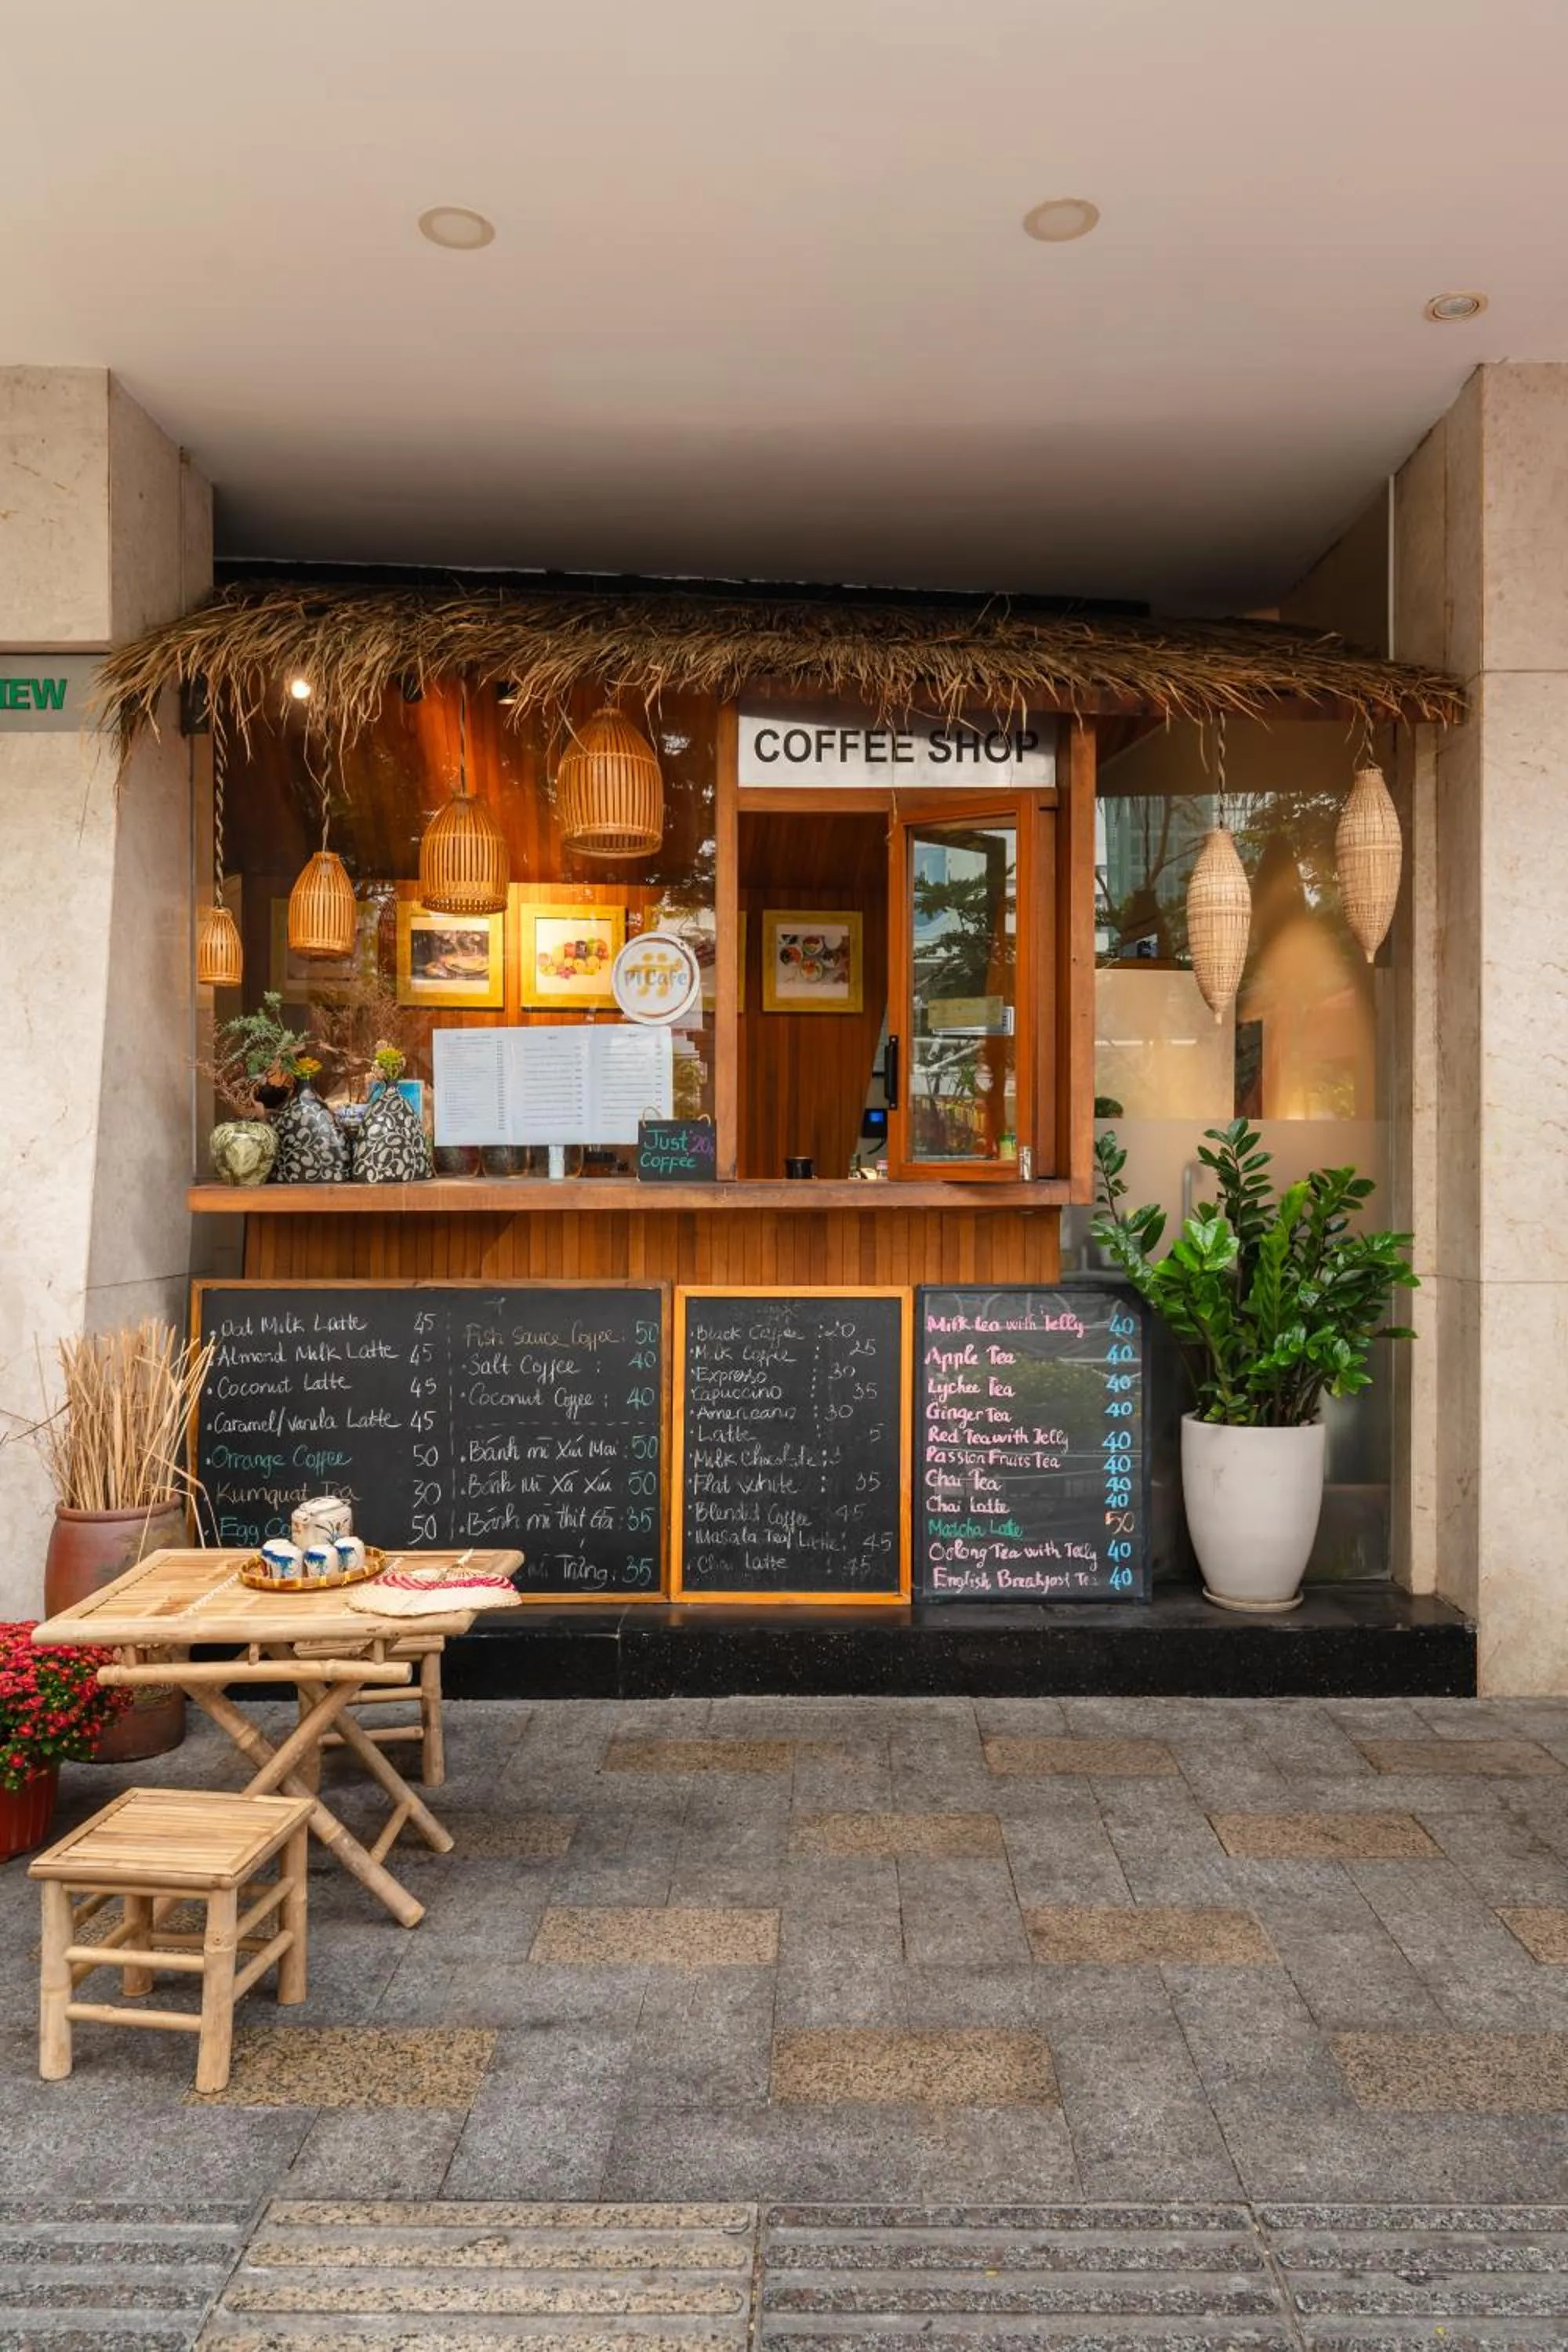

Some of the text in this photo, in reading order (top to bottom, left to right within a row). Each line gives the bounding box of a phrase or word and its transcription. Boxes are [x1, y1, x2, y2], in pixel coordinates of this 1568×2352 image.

[754, 728, 1039, 763] COFFEE SHOP
[644, 1129, 688, 1152] Just
[640, 1152, 696, 1174] Coffee
[220, 1311, 437, 1337] Oat Milk Latte 45
[465, 1322, 504, 1348] Fish
[635, 1320, 659, 1345] 50
[927, 1315, 971, 1334] Milk
[1006, 1313, 1037, 1330] with
[1109, 1314, 1134, 1337] 40
[217, 1339, 434, 1367] Almond Milk Latte 45
[849, 1338, 877, 1356] 25
[924, 1343, 1133, 1373] Apple Tea 40
[469, 1351, 656, 1385] Salt Coffee 40
[827, 1363, 856, 1380] 30
[217, 1371, 437, 1399] Coconut Latte 45
[469, 1381, 543, 1406] Coconut
[626, 1386, 655, 1410] 40
[852, 1382, 877, 1399] 35
[927, 1374, 1132, 1403] Lychee Tea 40
[347, 1407, 401, 1428] Latte
[410, 1410, 436, 1432] 45
[824, 1404, 854, 1421] 30
[925, 1401, 1133, 1429] Ginger Tea 40
[470, 1434, 520, 1461] Bánh
[631, 1433, 658, 1459] 50
[698, 1424, 757, 1443] Latte
[927, 1425, 960, 1443] Red
[1033, 1427, 1069, 1456] Jelly
[1102, 1431, 1131, 1454] 40
[292, 1444, 353, 1476] Coffee
[412, 1443, 438, 1466] 50
[694, 1448, 737, 1468] Milk
[926, 1445, 1131, 1475] Passion Fruits Tea 40
[628, 1471, 656, 1495] 50
[693, 1471, 731, 1496] Flat
[855, 1470, 881, 1492] 35
[924, 1467, 1132, 1492] Chai Tea 40
[215, 1482, 311, 1512] Kumquat
[412, 1479, 441, 1508] 30
[926, 1492, 1129, 1514] Chai Latte 40
[695, 1501, 760, 1523] Blended
[927, 1517, 986, 1537] Matcha
[1105, 1511, 1134, 1535] 50
[220, 1518, 260, 1547] Egg
[408, 1514, 437, 1545] 50
[696, 1526, 757, 1545] Masala
[863, 1531, 894, 1553] 45
[746, 1550, 789, 1571] Latte
[929, 1538, 1132, 1572] Oolong Tea with Jelly 40
[622, 1555, 653, 1587] 35
[933, 1566, 992, 1594] English
[1109, 1566, 1133, 1591] 40
